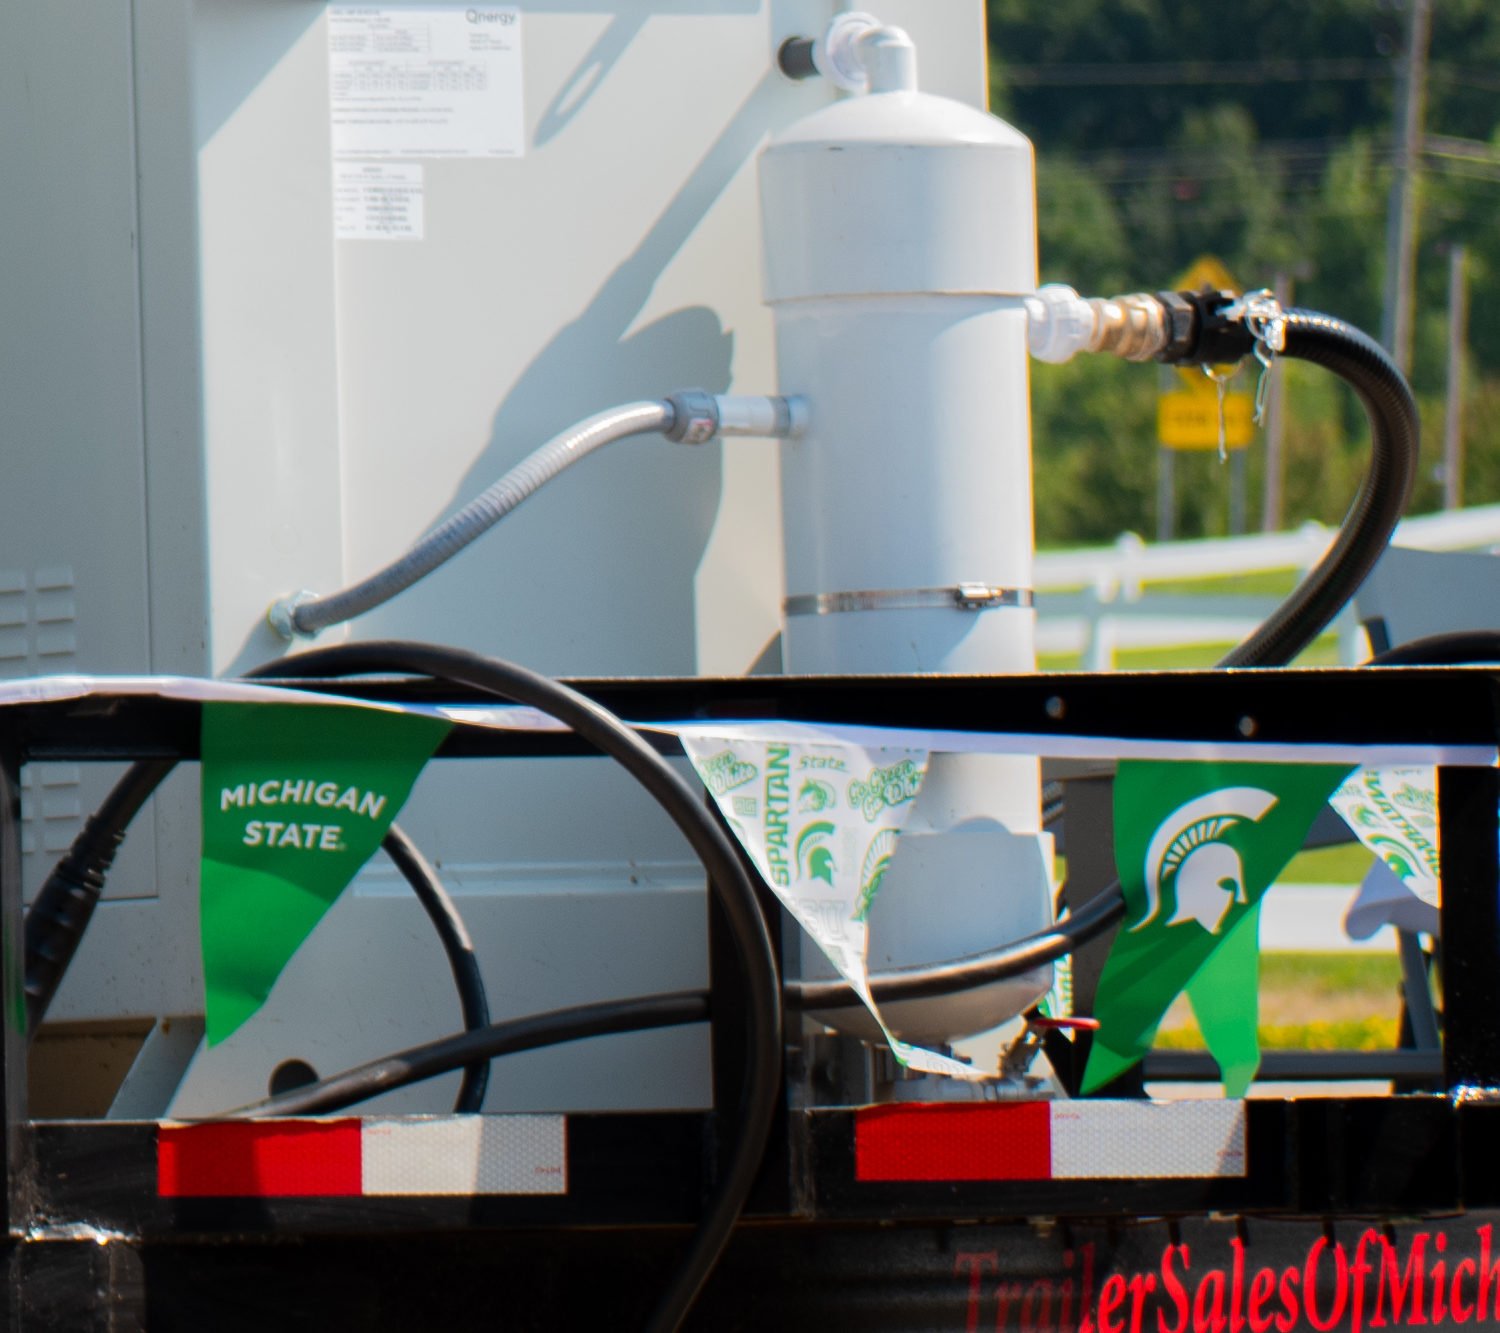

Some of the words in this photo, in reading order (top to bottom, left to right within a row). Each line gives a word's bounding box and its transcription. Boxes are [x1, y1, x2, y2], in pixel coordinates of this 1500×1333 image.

[466, 8, 516, 26] Qnergy
[798, 754, 850, 772] State
[221, 780, 386, 819] MICHIGAN
[243, 821, 341, 850] STATE
